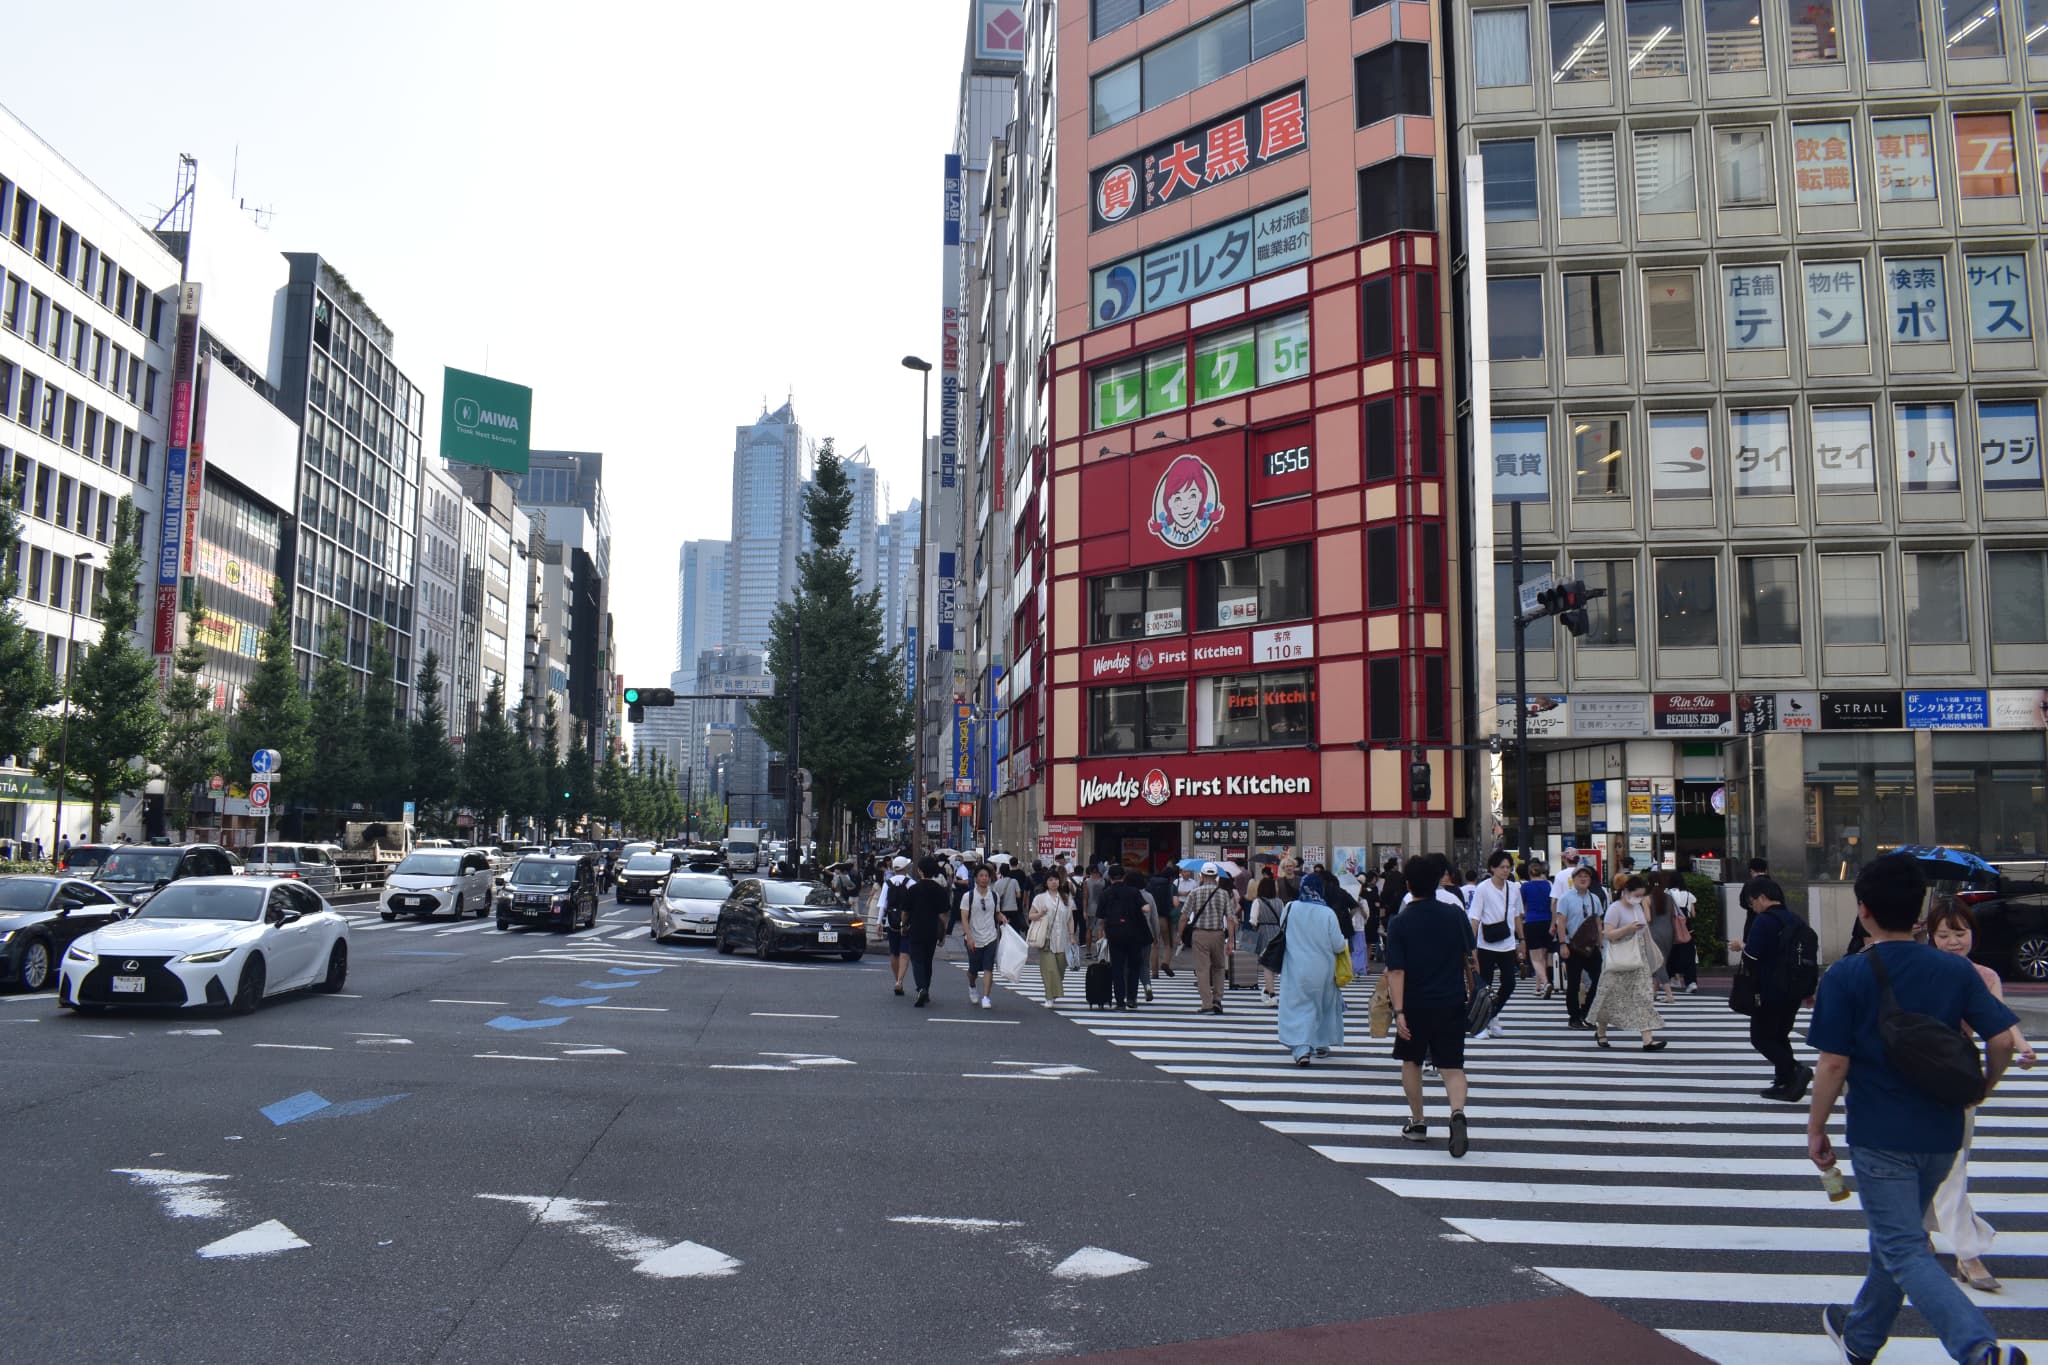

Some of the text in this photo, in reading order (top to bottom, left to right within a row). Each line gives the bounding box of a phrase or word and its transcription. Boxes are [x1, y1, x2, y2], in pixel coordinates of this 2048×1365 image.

[1158, 90, 1305, 201] 大黒屋
[1794, 133, 1929, 162] 飲食 専門
[1102, 168, 1132, 218] 質
[1796, 165, 1850, 192] 転職
[949, 192, 960, 222] LABI
[1256, 207, 1309, 240] 人材派遣
[1256, 231, 1310, 262] 職業紹介
[1145, 229, 1250, 304] デルタ
[1729, 264, 2020, 298] 店舗 物件 検索 サイト
[943, 323, 957, 371] LABI
[1116, 335, 1309, 418] レイク 5F
[480, 409, 519, 431] MIWA
[942, 377, 957, 447] SHINJUKU
[1270, 446, 1309, 475] 15:56
[1494, 452, 1542, 477] 賃貸
[167, 469, 184, 509] JAPAN
[165, 510, 182, 544] TOTAL
[162, 546, 178, 579] CLUB
[943, 592, 954, 624] LABI
[1266, 643, 1303, 661] 110席
[1273, 631, 1292, 643] 客席
[1093, 644, 1243, 676] Wendy's First Kitchen
[1669, 695, 1715, 708] Rin Rin
[1834, 703, 1888, 714] STRAIL
[1908, 703, 1983, 713] レンタルオフィス
[1666, 713, 1720, 725] REGULUS ZERO
[1080, 771, 1311, 808] Wendy's First Kitchen
[888, 805, 903, 816] 414
[1201, 830, 1248, 840] 34 39 39
